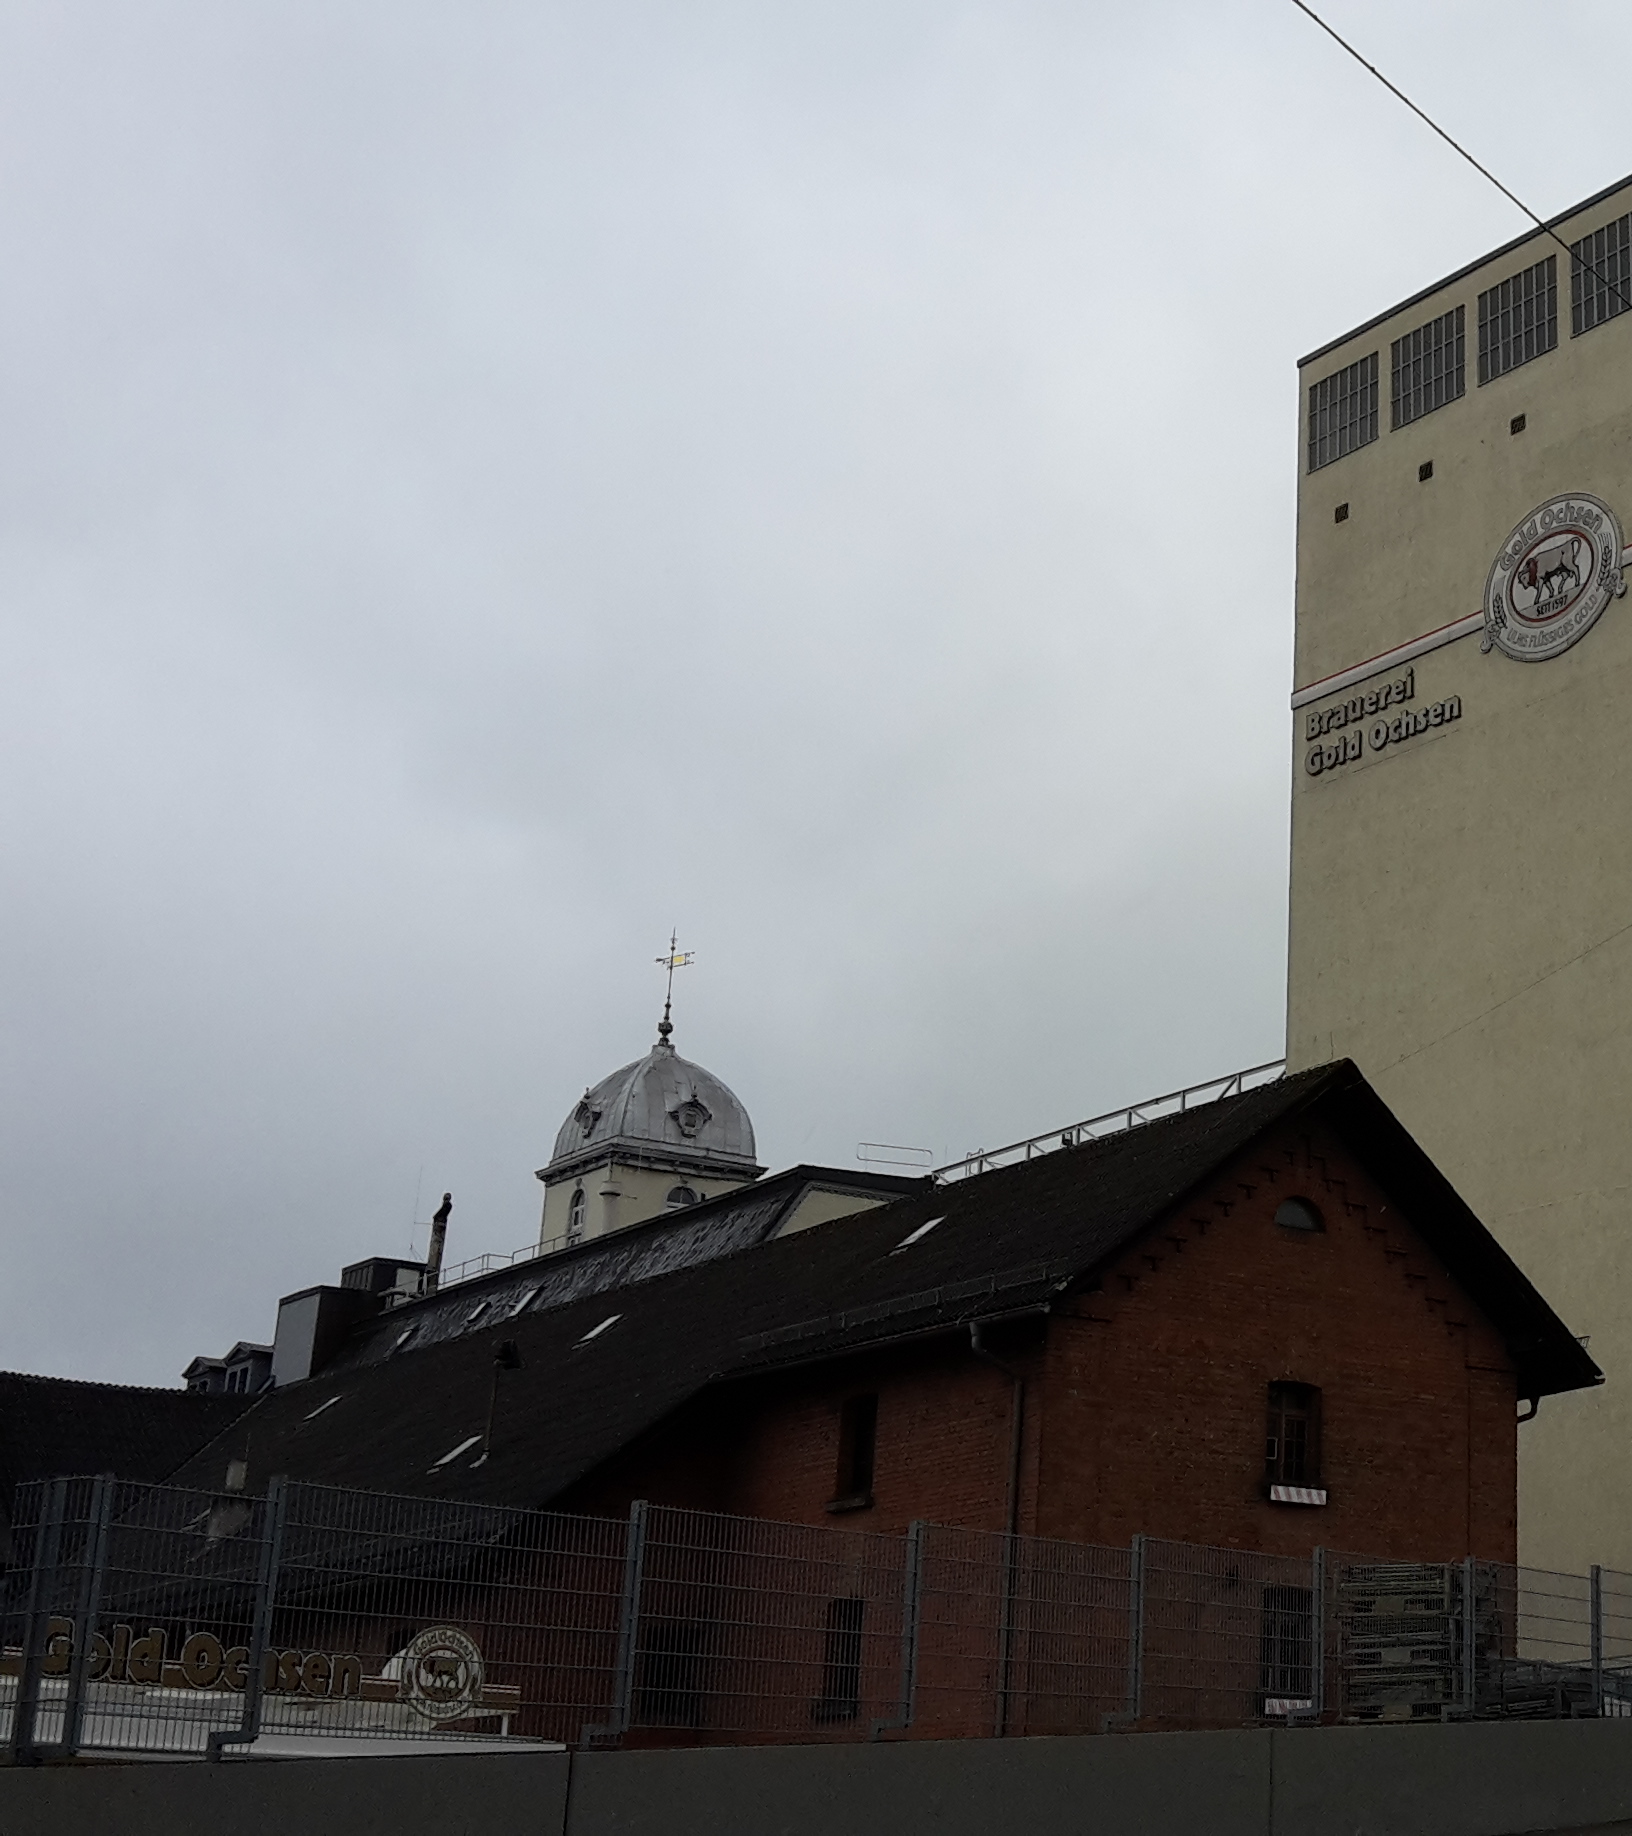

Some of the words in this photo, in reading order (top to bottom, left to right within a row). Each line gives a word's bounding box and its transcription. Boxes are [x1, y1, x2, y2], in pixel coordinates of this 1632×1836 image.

[1500, 519, 1538, 571] Gold
[1540, 502, 1604, 534] Ochsen
[1574, 594, 1598, 625] GOLD
[1305, 730, 1363, 776] Gold
[1368, 694, 1462, 750] Ochsen
[1306, 665, 1415, 741] Brauerei
[414, 1631, 438, 1655] Gold
